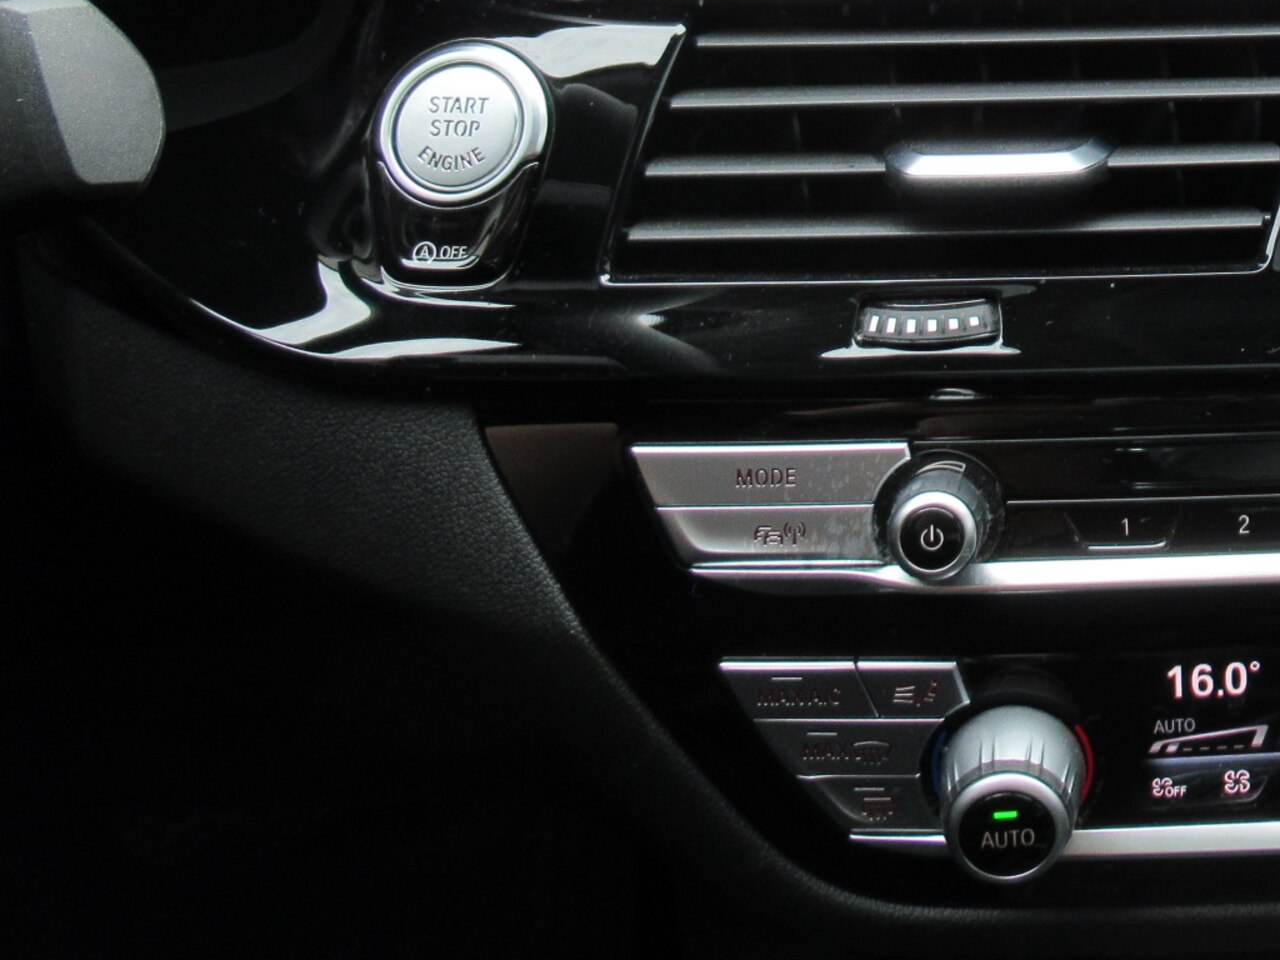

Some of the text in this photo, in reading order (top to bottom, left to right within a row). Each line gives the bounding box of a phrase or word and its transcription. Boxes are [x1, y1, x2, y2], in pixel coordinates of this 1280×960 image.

[428, 96, 489, 115] START
[430, 119, 480, 137] STOP
[417, 145, 486, 172] ENGINE
[440, 245, 468, 259] OFF
[735, 468, 797, 488] MODE
[1121, 518, 1130, 536] 1
[1238, 515, 1251, 534] 2
[1153, 718, 1196, 734] AUTO
[1165, 785, 1187, 798] OFF
[981, 828, 1036, 849] AUTO
